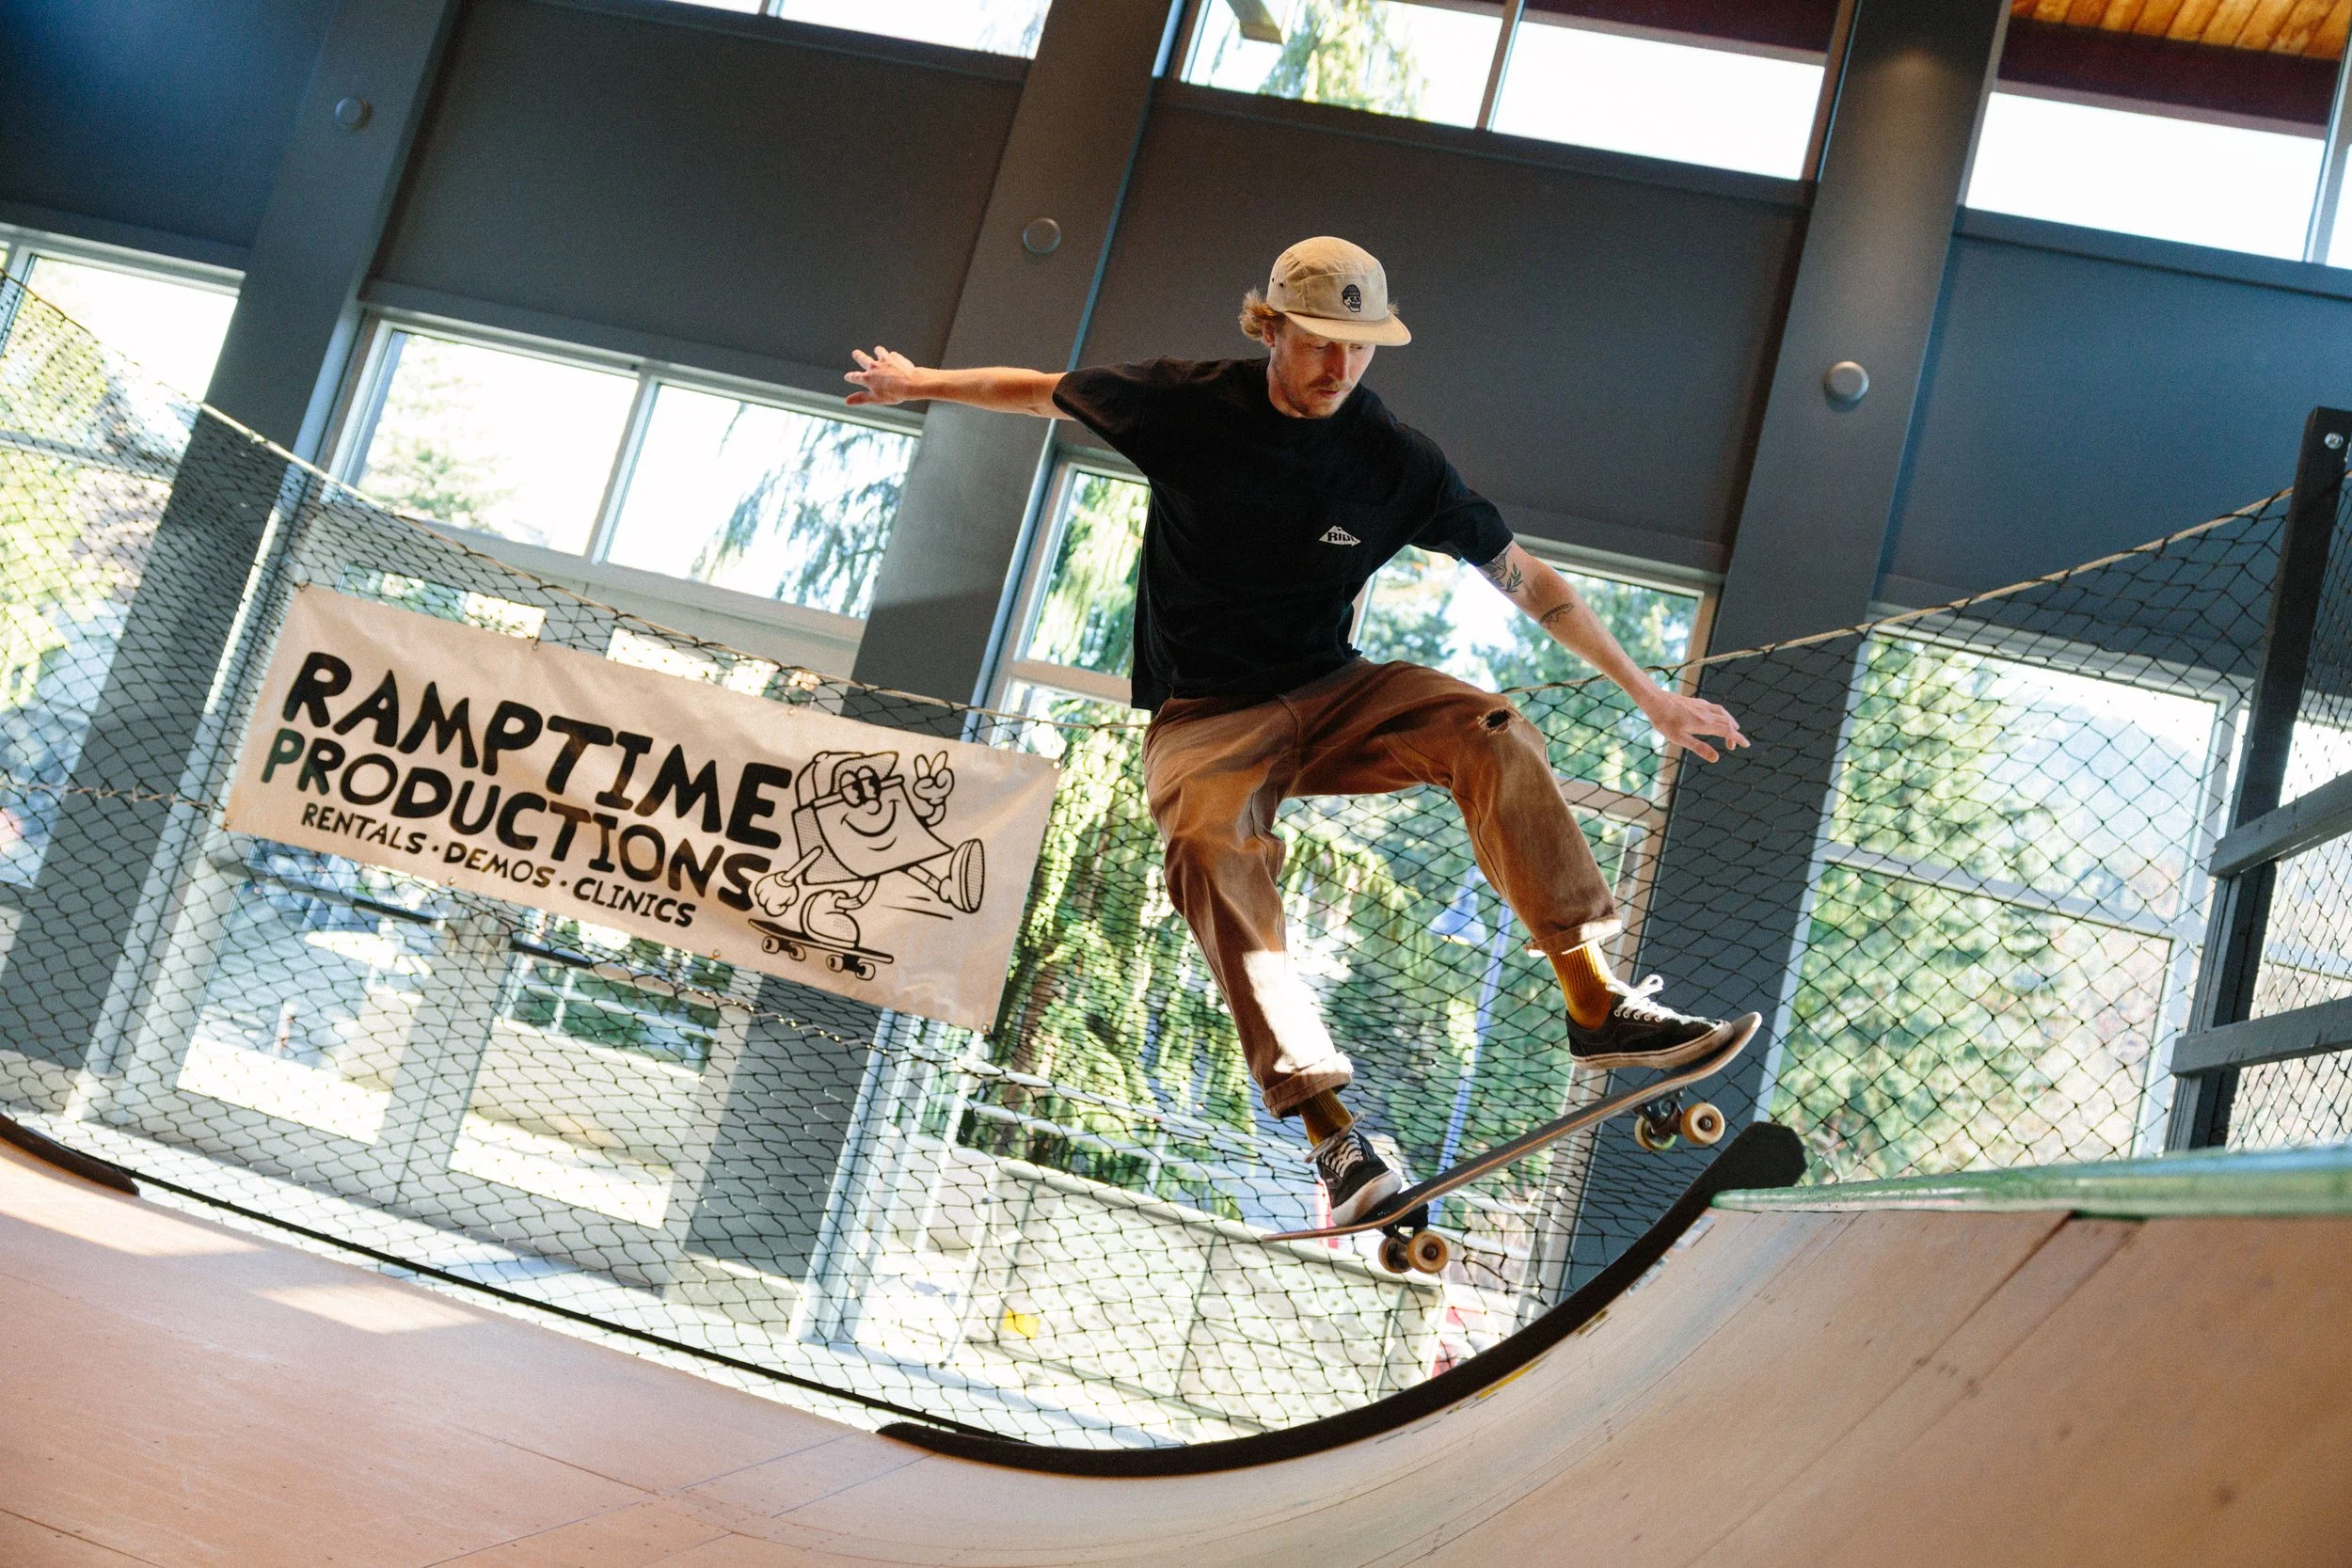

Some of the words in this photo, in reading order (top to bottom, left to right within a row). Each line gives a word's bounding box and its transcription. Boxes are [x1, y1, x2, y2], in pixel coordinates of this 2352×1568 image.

[261, 728, 771, 912] PRODUCTIONS
[281, 651, 793, 851] RAMPTIME
[301, 802, 427, 855] RENTALS
[443, 841, 556, 888] DEMOS
[573, 877, 697, 928] CLINICS
